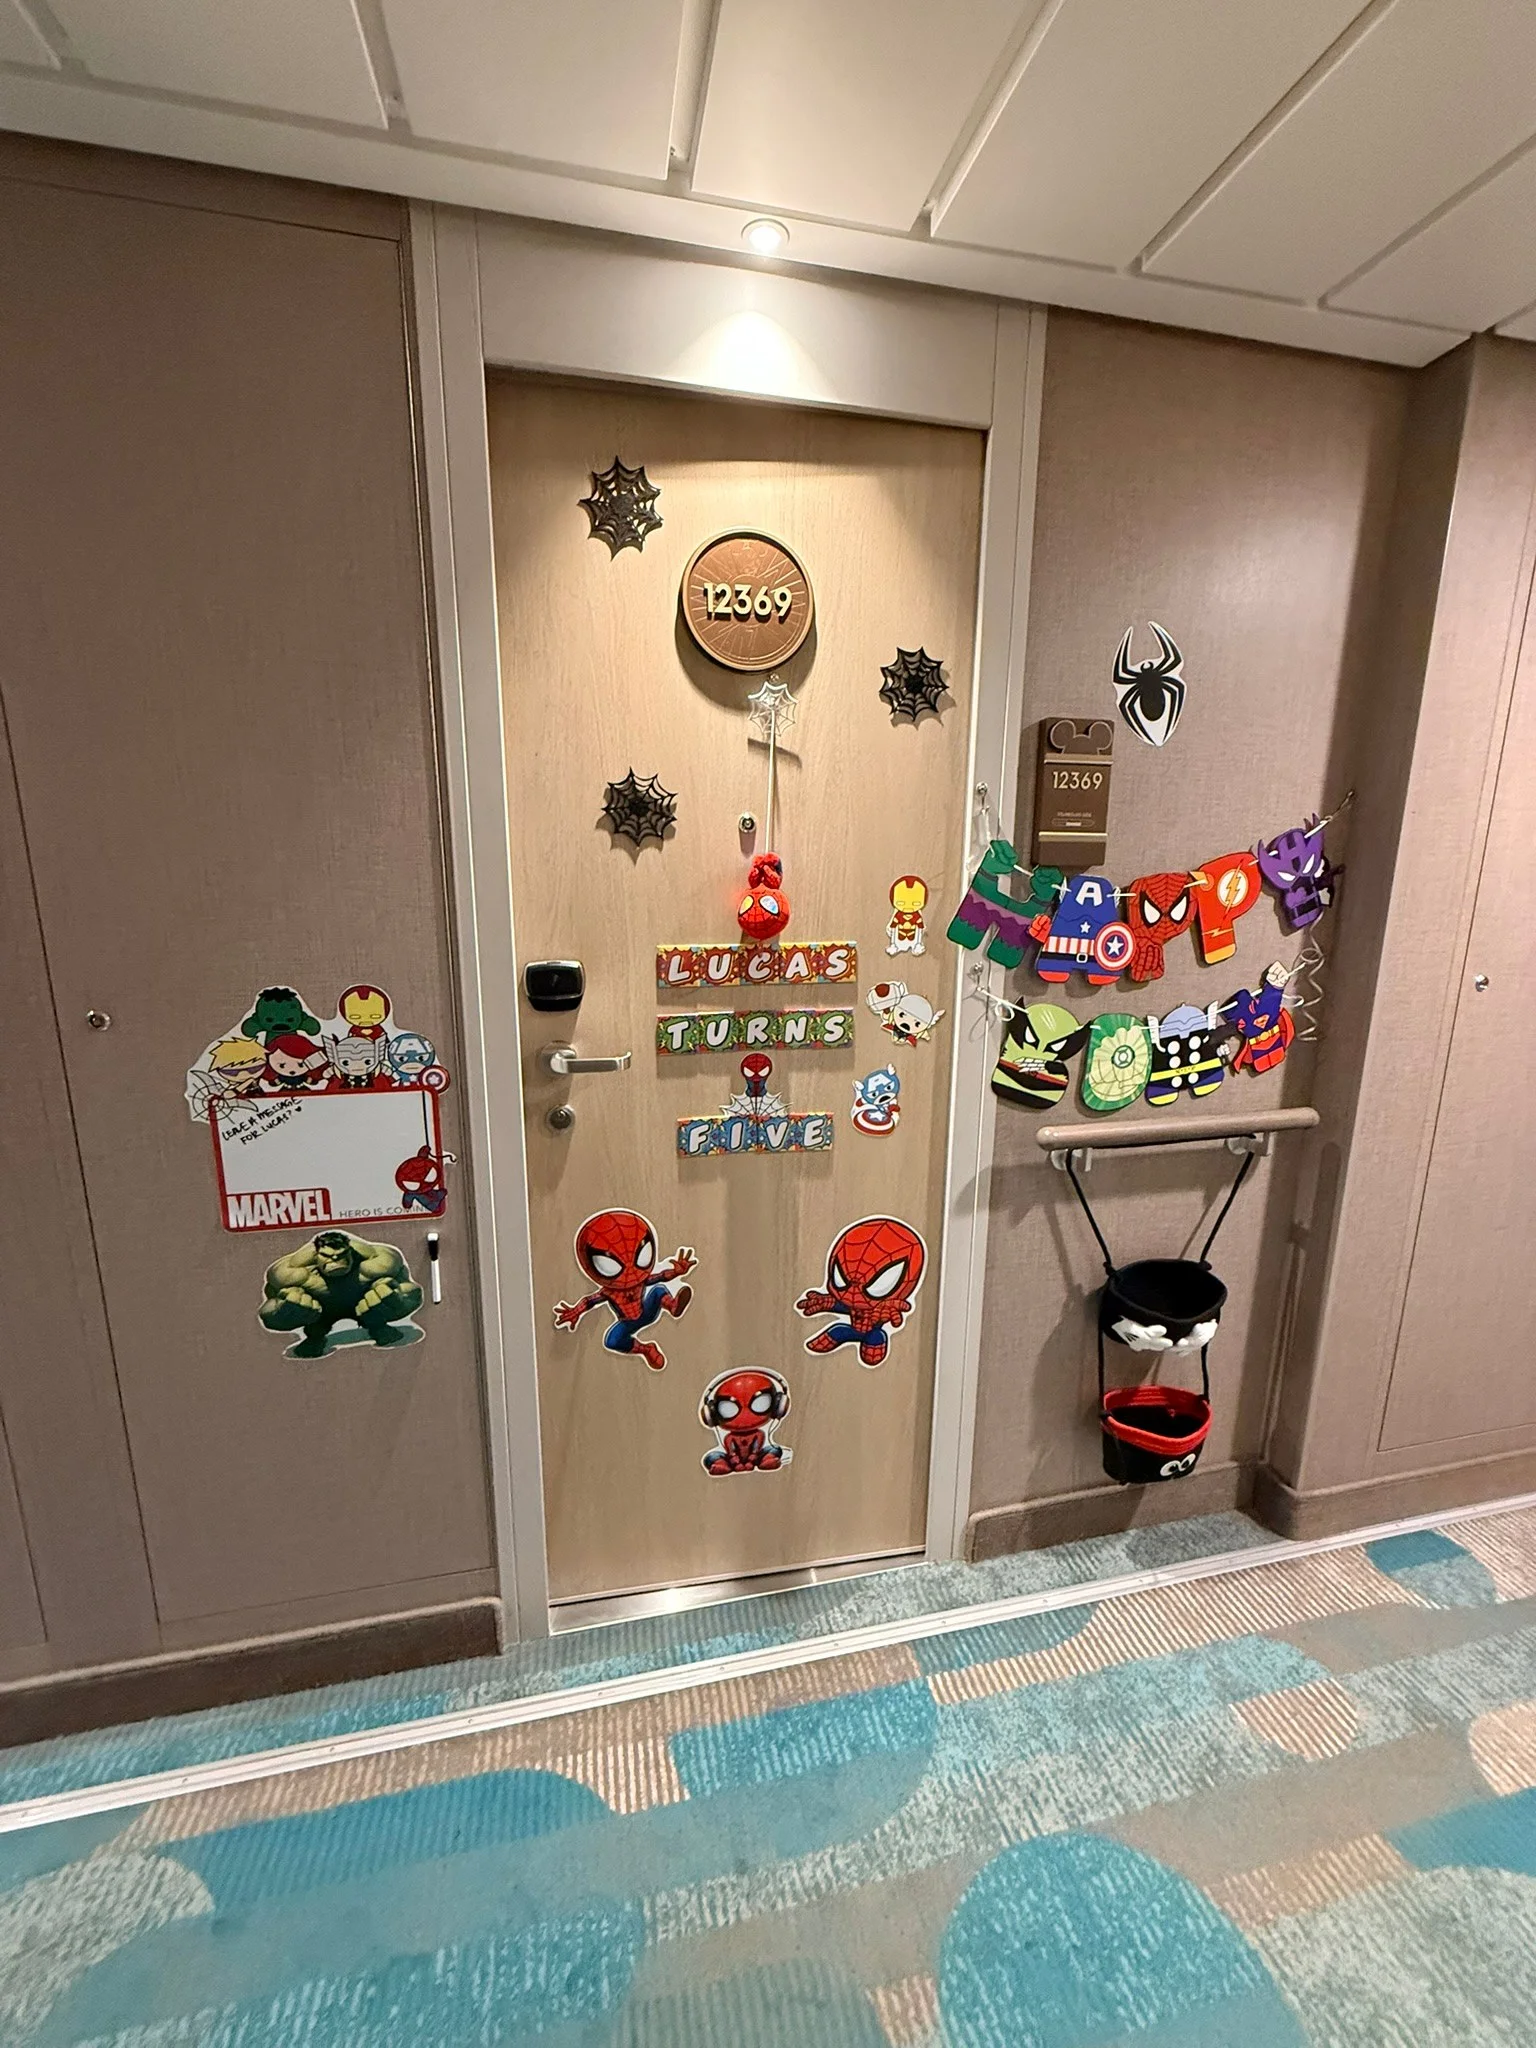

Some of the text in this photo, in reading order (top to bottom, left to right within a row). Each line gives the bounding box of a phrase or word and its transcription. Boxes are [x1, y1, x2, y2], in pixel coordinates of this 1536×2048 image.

[703, 582, 793, 619] 12369
[1052, 771, 1103, 790] 12369
[667, 948, 848, 982] LUCAS
[667, 1015, 846, 1050] TURNS
[240, 1129, 263, 1145] FOR
[688, 1117, 825, 1154] FIVE
[226, 1189, 331, 1229] MARVEL
[339, 1208, 371, 1218] HERO
[373, 1207, 383, 1216] IS
